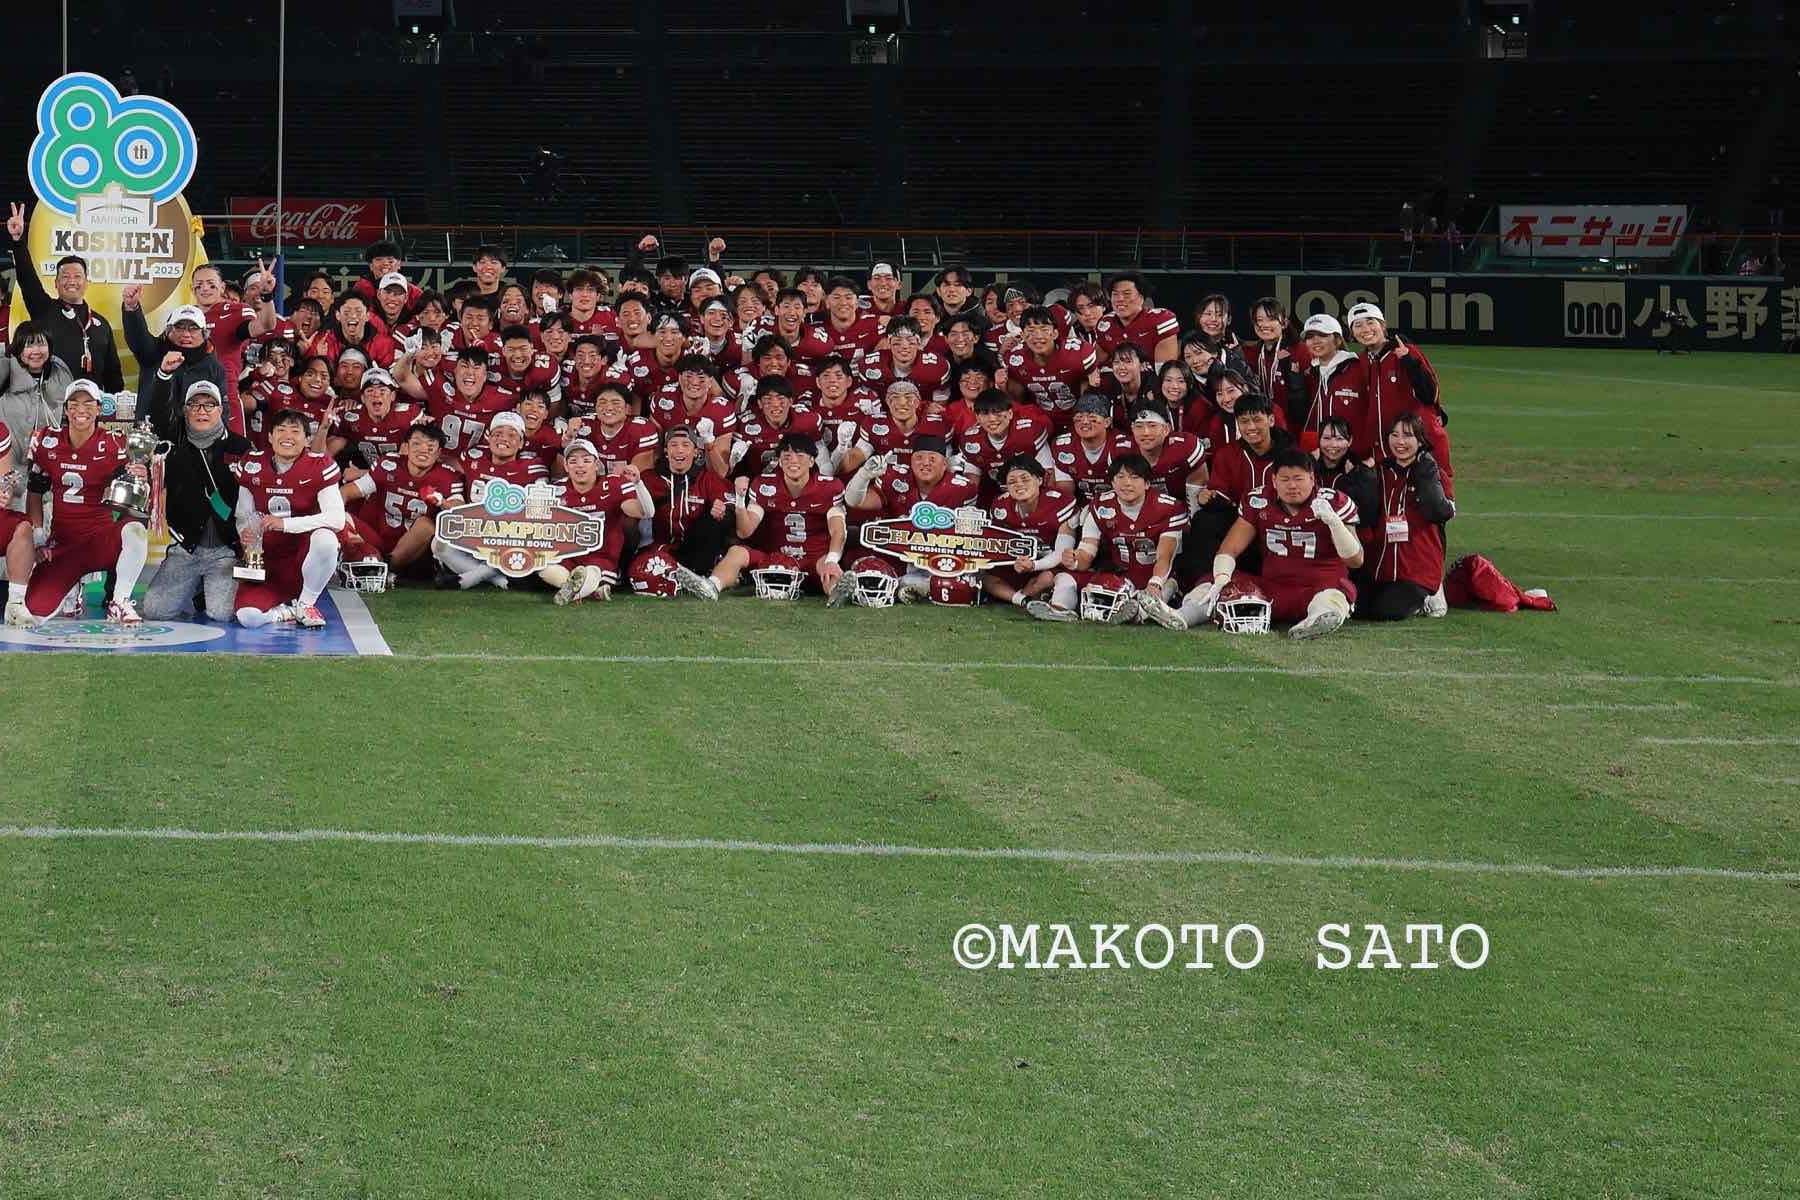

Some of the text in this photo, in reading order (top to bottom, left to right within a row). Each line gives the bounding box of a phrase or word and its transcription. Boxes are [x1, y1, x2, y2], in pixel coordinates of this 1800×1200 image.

[132, 145, 148, 160] th
[90, 215, 139, 225] MAINICHI
[250, 202, 365, 240] Coca-Cola
[1504, 216, 1684, 246] 不二サッシ
[55, 230, 171, 253] KOSHIEN
[154, 265, 181, 276] 2025
[441, 414, 487, 449] 97
[61, 472, 84, 504] 2
[384, 491, 429, 531] 53
[440, 514, 600, 547] CHAMPIONS
[483, 537, 554, 549] KOSHIEN BOWL
[783, 513, 808, 543] 3
[865, 525, 1035, 558] CHAMPIONS
[911, 545, 985, 558] KOSHIEN BOWL
[941, 588, 949, 601] 6
